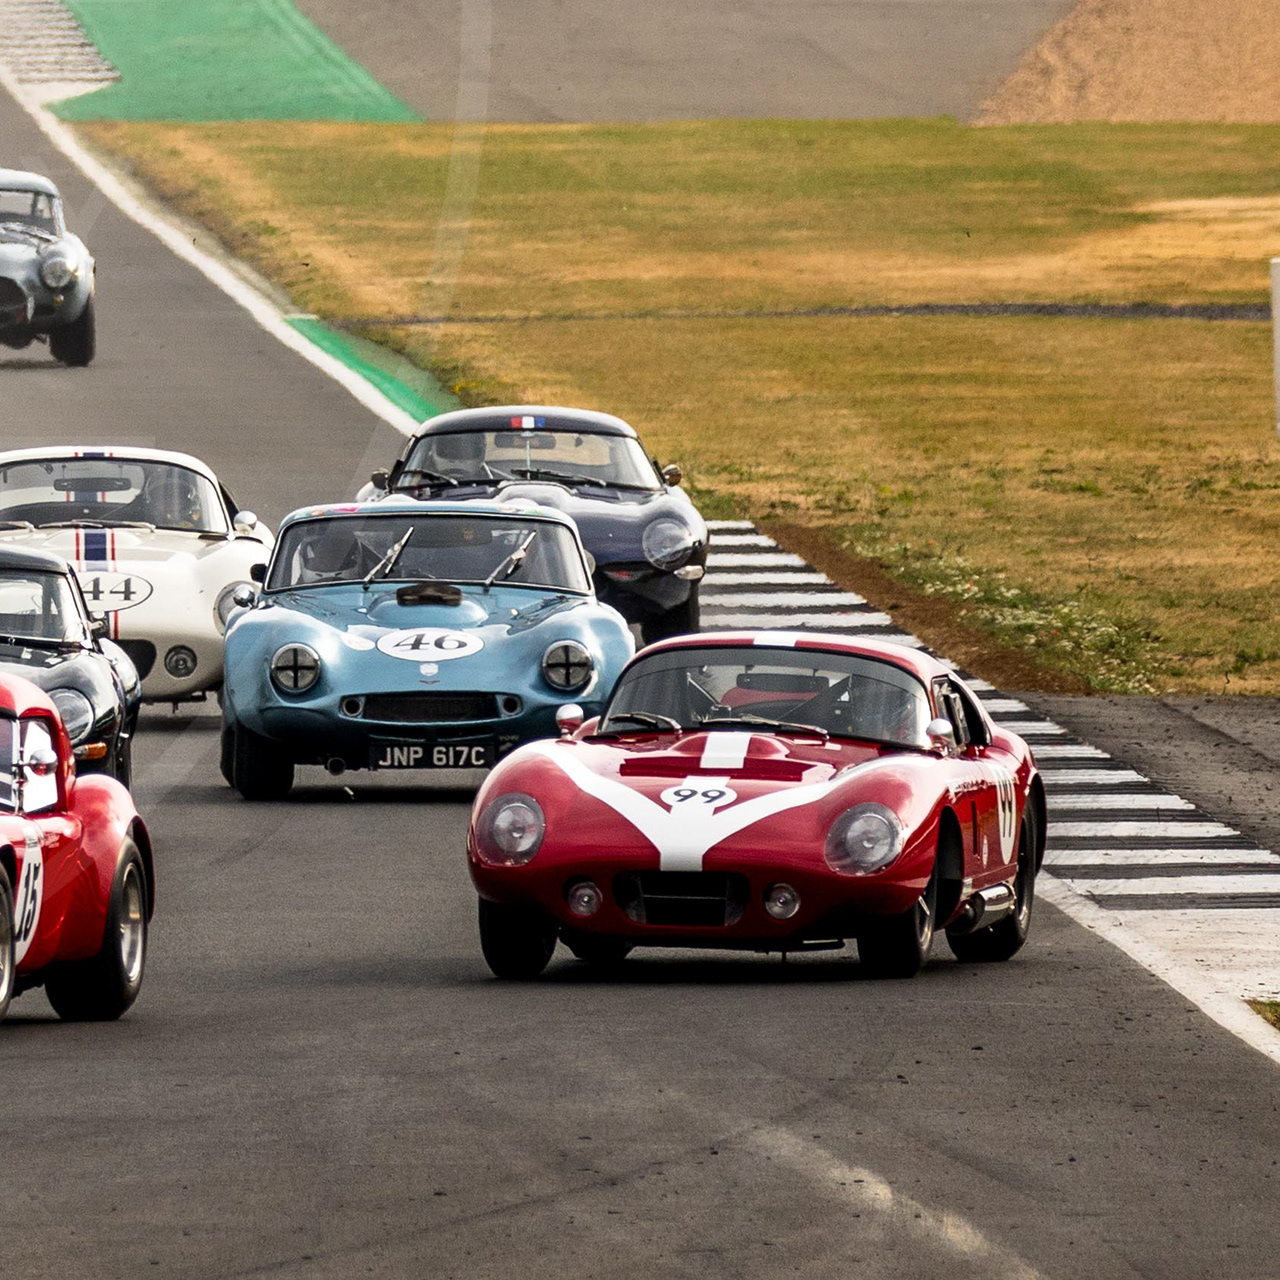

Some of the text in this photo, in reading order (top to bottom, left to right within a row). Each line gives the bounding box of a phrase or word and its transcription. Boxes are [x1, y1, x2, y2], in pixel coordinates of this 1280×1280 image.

[82, 576, 137, 601] 44
[392, 633, 468, 651] 46
[379, 747, 485, 766] JNP 617C
[673, 788, 727, 804] 99
